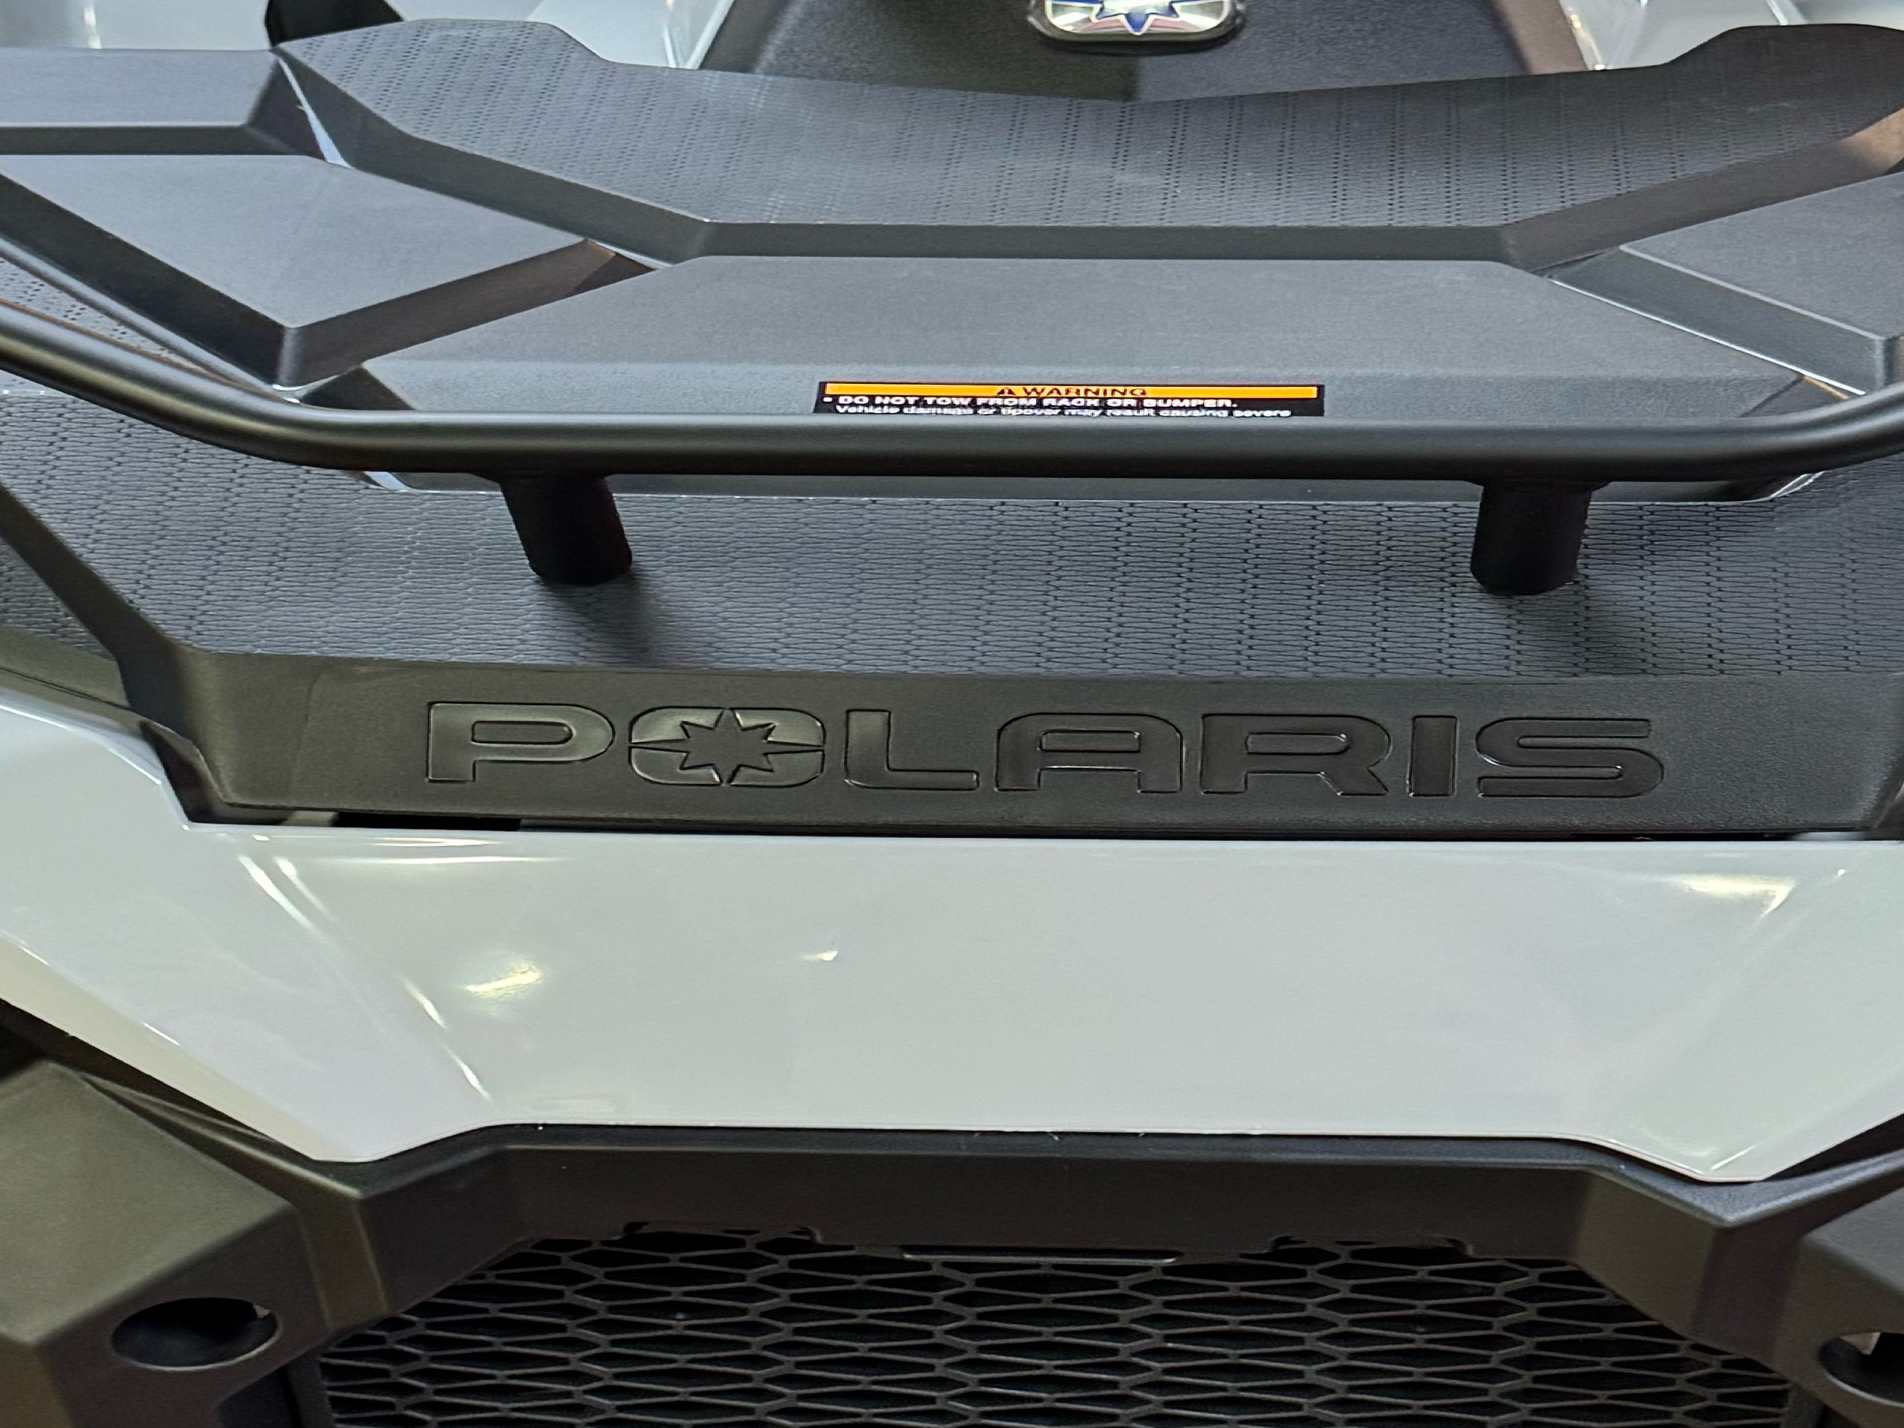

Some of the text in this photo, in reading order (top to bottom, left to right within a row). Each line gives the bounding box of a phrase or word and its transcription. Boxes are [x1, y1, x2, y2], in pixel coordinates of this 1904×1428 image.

[1022, 386, 1148, 399] WARNING
[838, 396, 1239, 409] DO NOT TOW FROM RACK OR BUMPER.
[835, 404, 900, 415] Vehicle
[426, 701, 1665, 799] POLARIS
